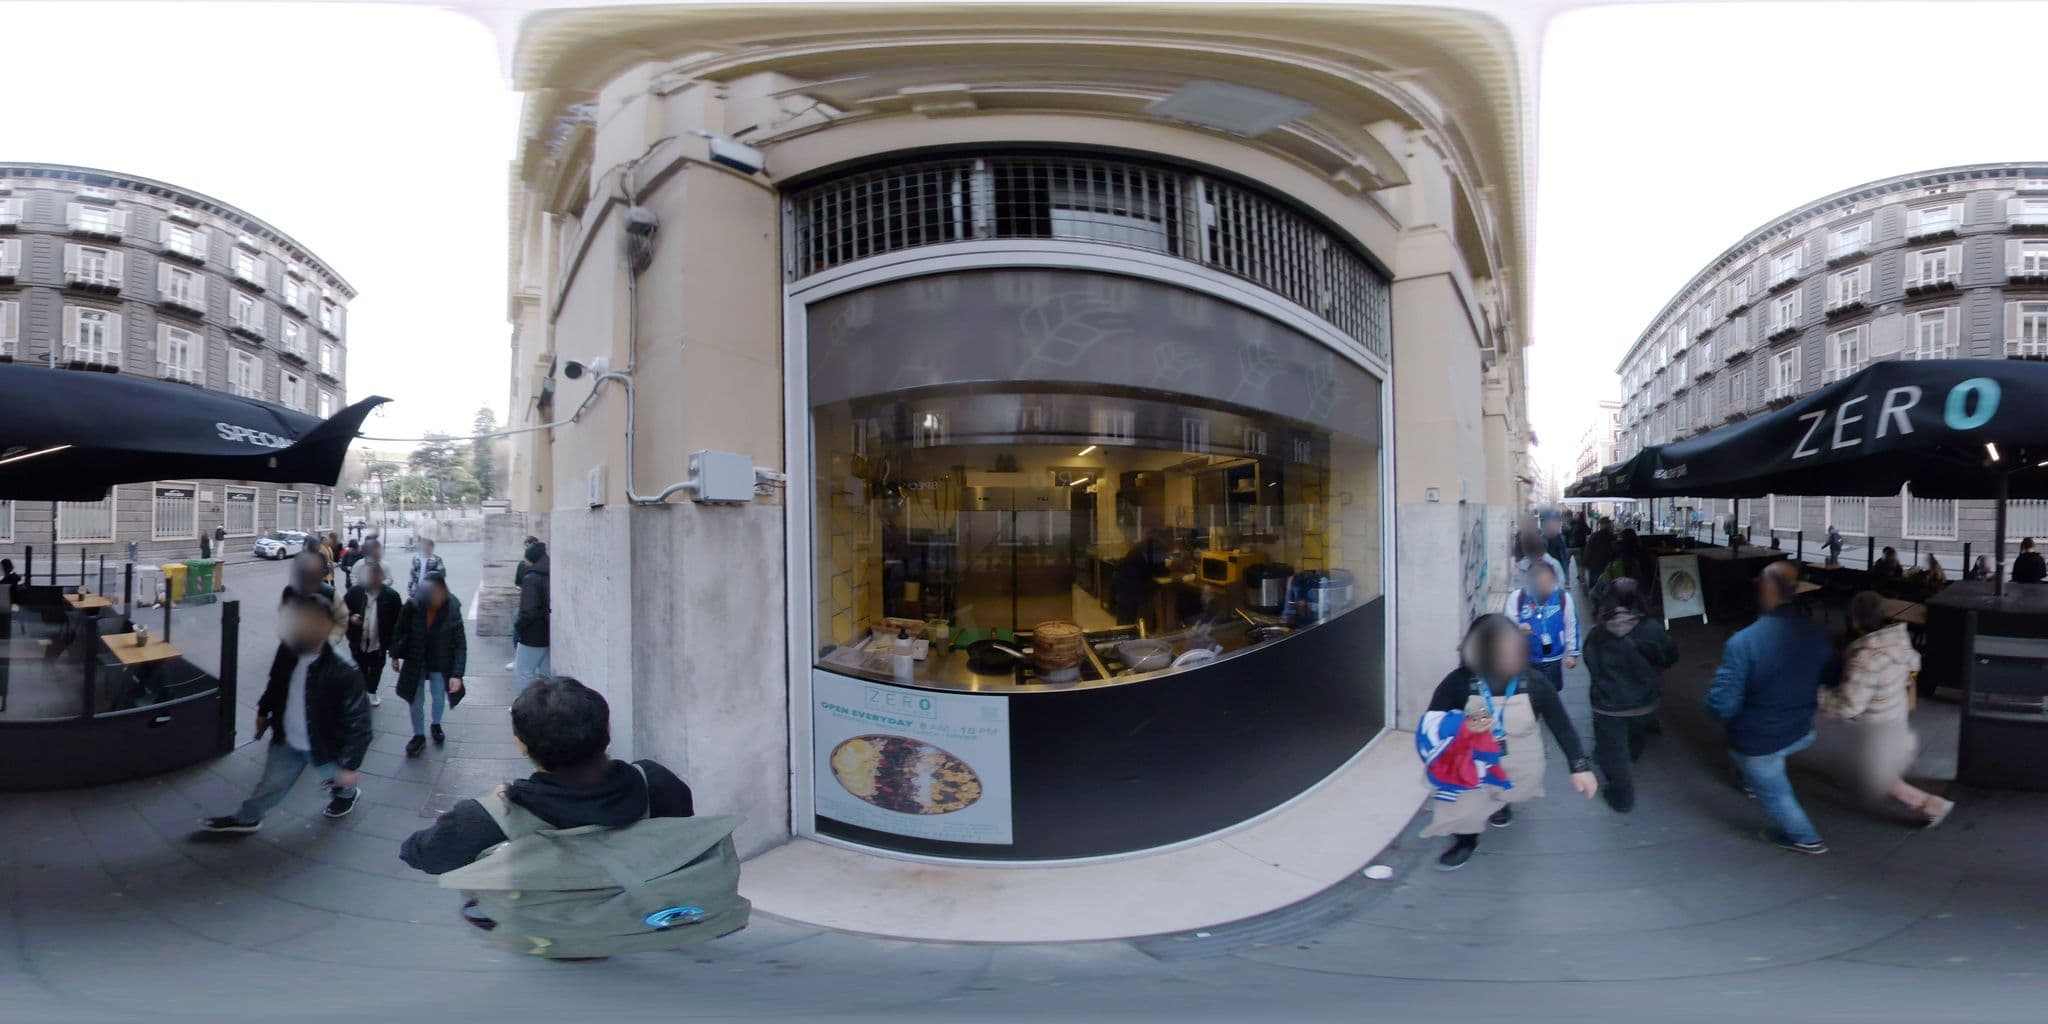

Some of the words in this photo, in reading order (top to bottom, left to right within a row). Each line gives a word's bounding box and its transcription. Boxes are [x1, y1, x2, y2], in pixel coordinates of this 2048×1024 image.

[1792, 377, 2001, 459] ZERO
[869, 689, 931, 711] ZERO
[821, 701, 849, 714] OPEN
[851, 709, 913, 726] EVERYDAY
